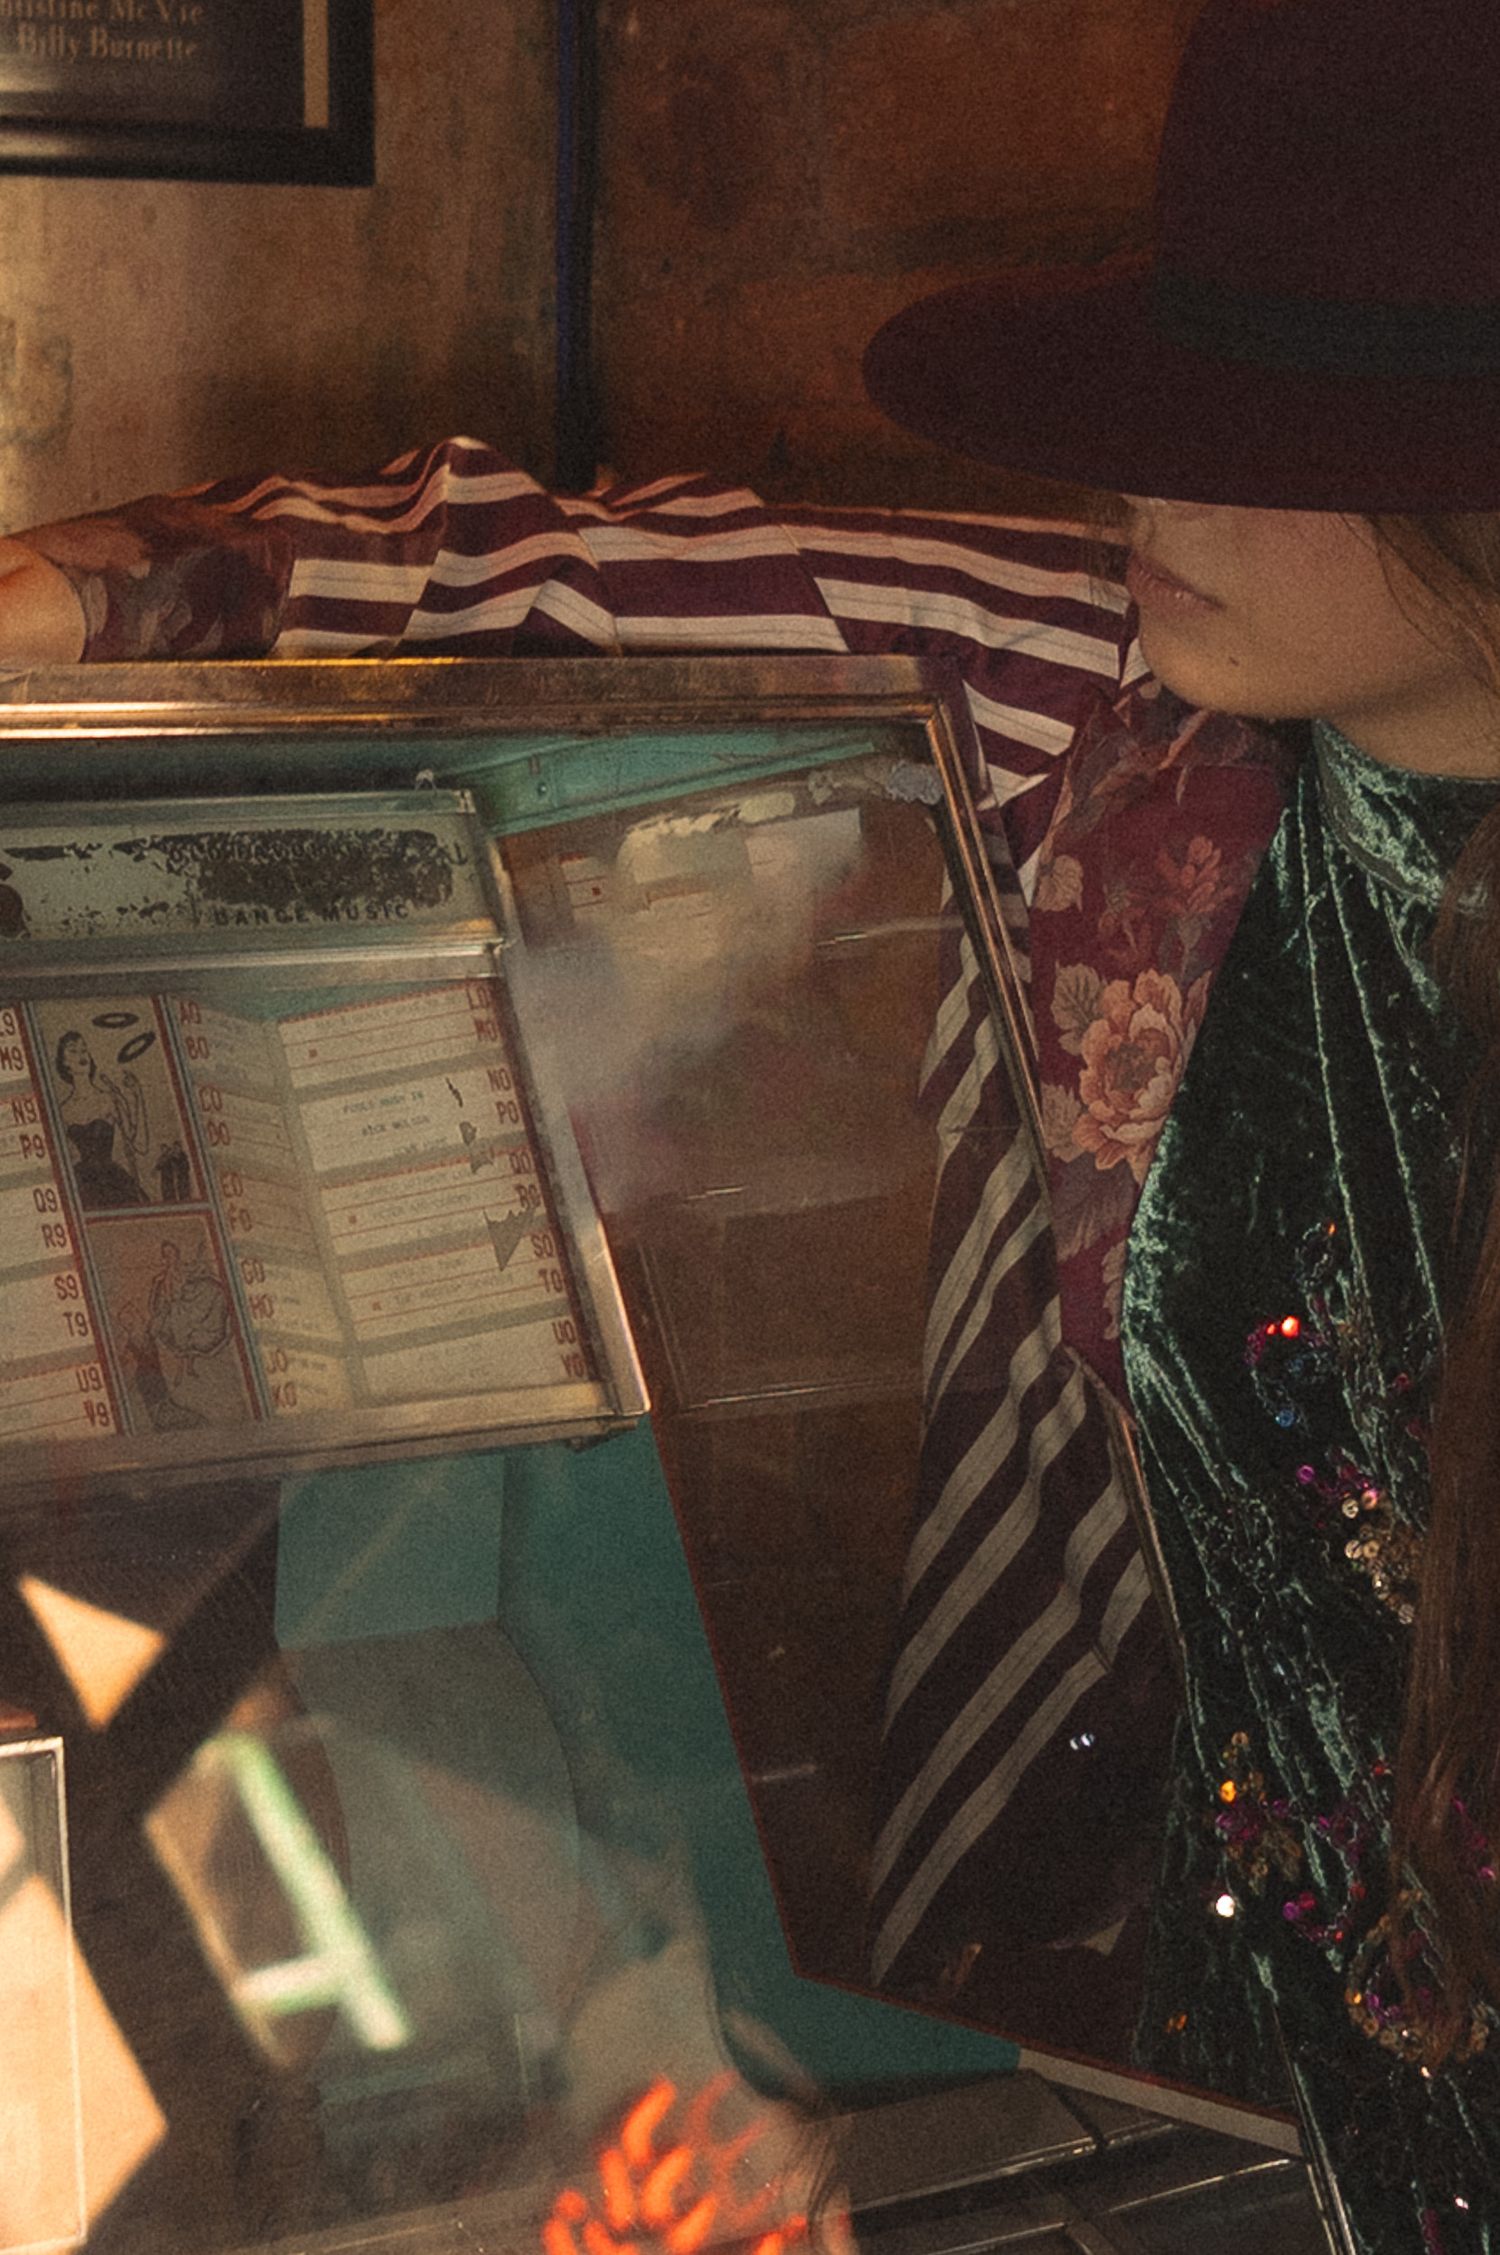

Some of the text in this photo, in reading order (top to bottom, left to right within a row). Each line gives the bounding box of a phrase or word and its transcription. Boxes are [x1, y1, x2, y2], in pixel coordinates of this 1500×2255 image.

[18, 22, 198, 64] Billy Burnette
[213, 900, 409, 926] DANCE MUSIC
[12, 1099, 37, 1124] N9
[20, 1133, 46, 1159] P9
[33, 1188, 58, 1213] Q9
[42, 1223, 68, 1248] R9
[54, 1274, 80, 1300] S9
[63, 1311, 89, 1337] T9
[76, 1366, 103, 1392] U9
[83, 1402, 110, 1427] V9
